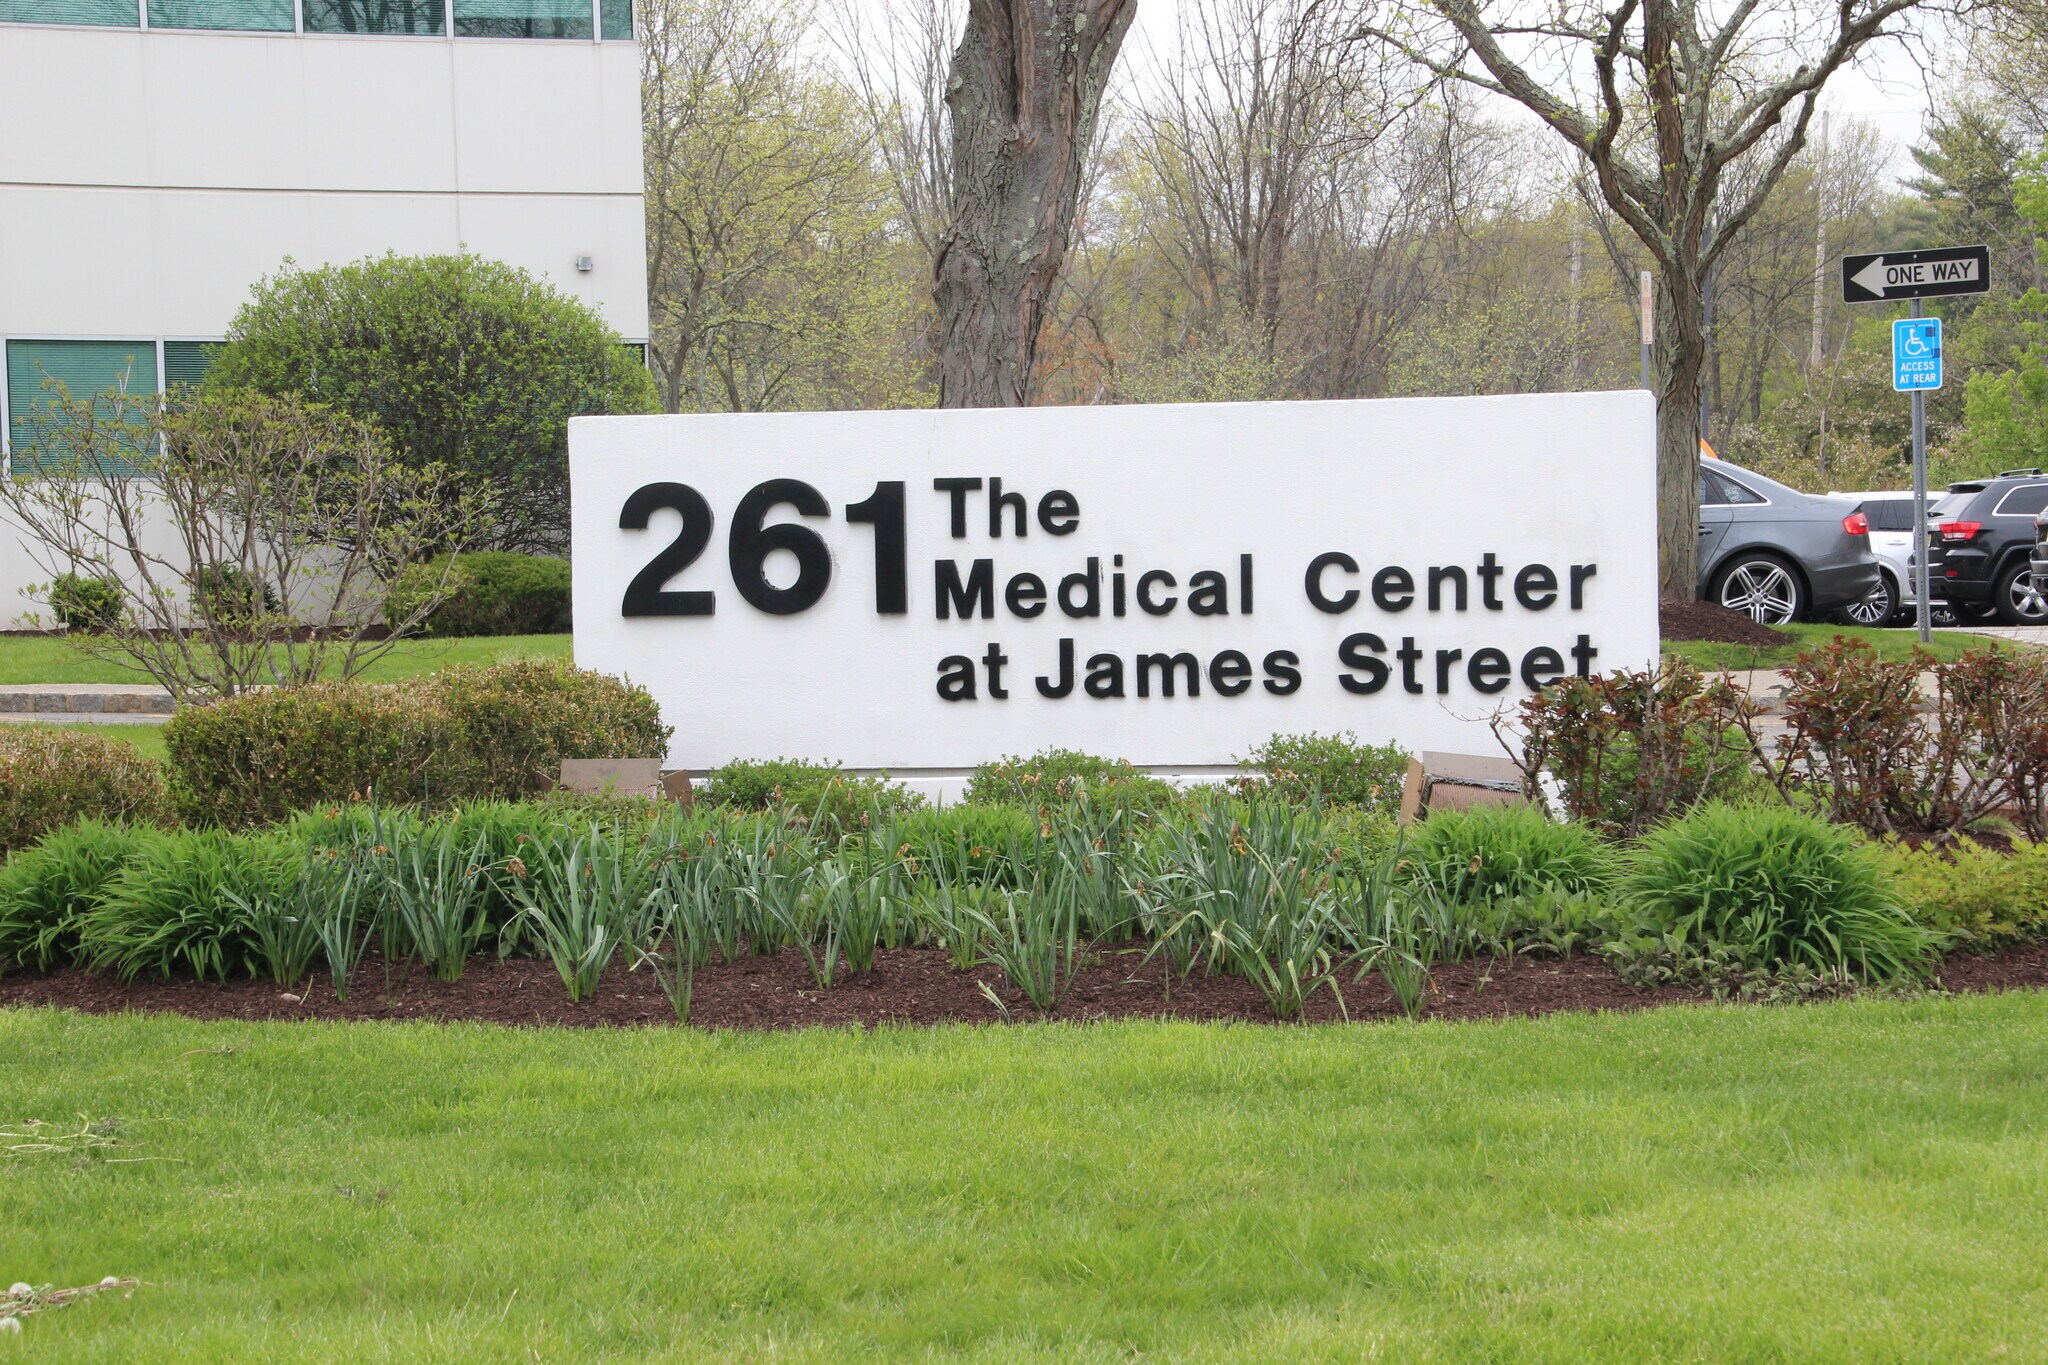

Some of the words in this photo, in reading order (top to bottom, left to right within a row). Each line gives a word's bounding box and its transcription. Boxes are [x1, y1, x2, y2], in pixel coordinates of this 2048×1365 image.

[1886, 266, 1924, 284] ONE
[1932, 261, 1972, 280] WAY
[1899, 374, 1910, 384] AT
[1913, 373, 1936, 383] REAR
[1900, 361, 1935, 372] ACCESS
[933, 477, 1080, 539] The
[618, 478, 908, 617] 261
[934, 553, 1253, 620] Medical
[1304, 551, 1597, 615] Center
[936, 642, 1009, 701] at
[1035, 638, 1302, 700] James
[1338, 632, 1598, 696] Street
